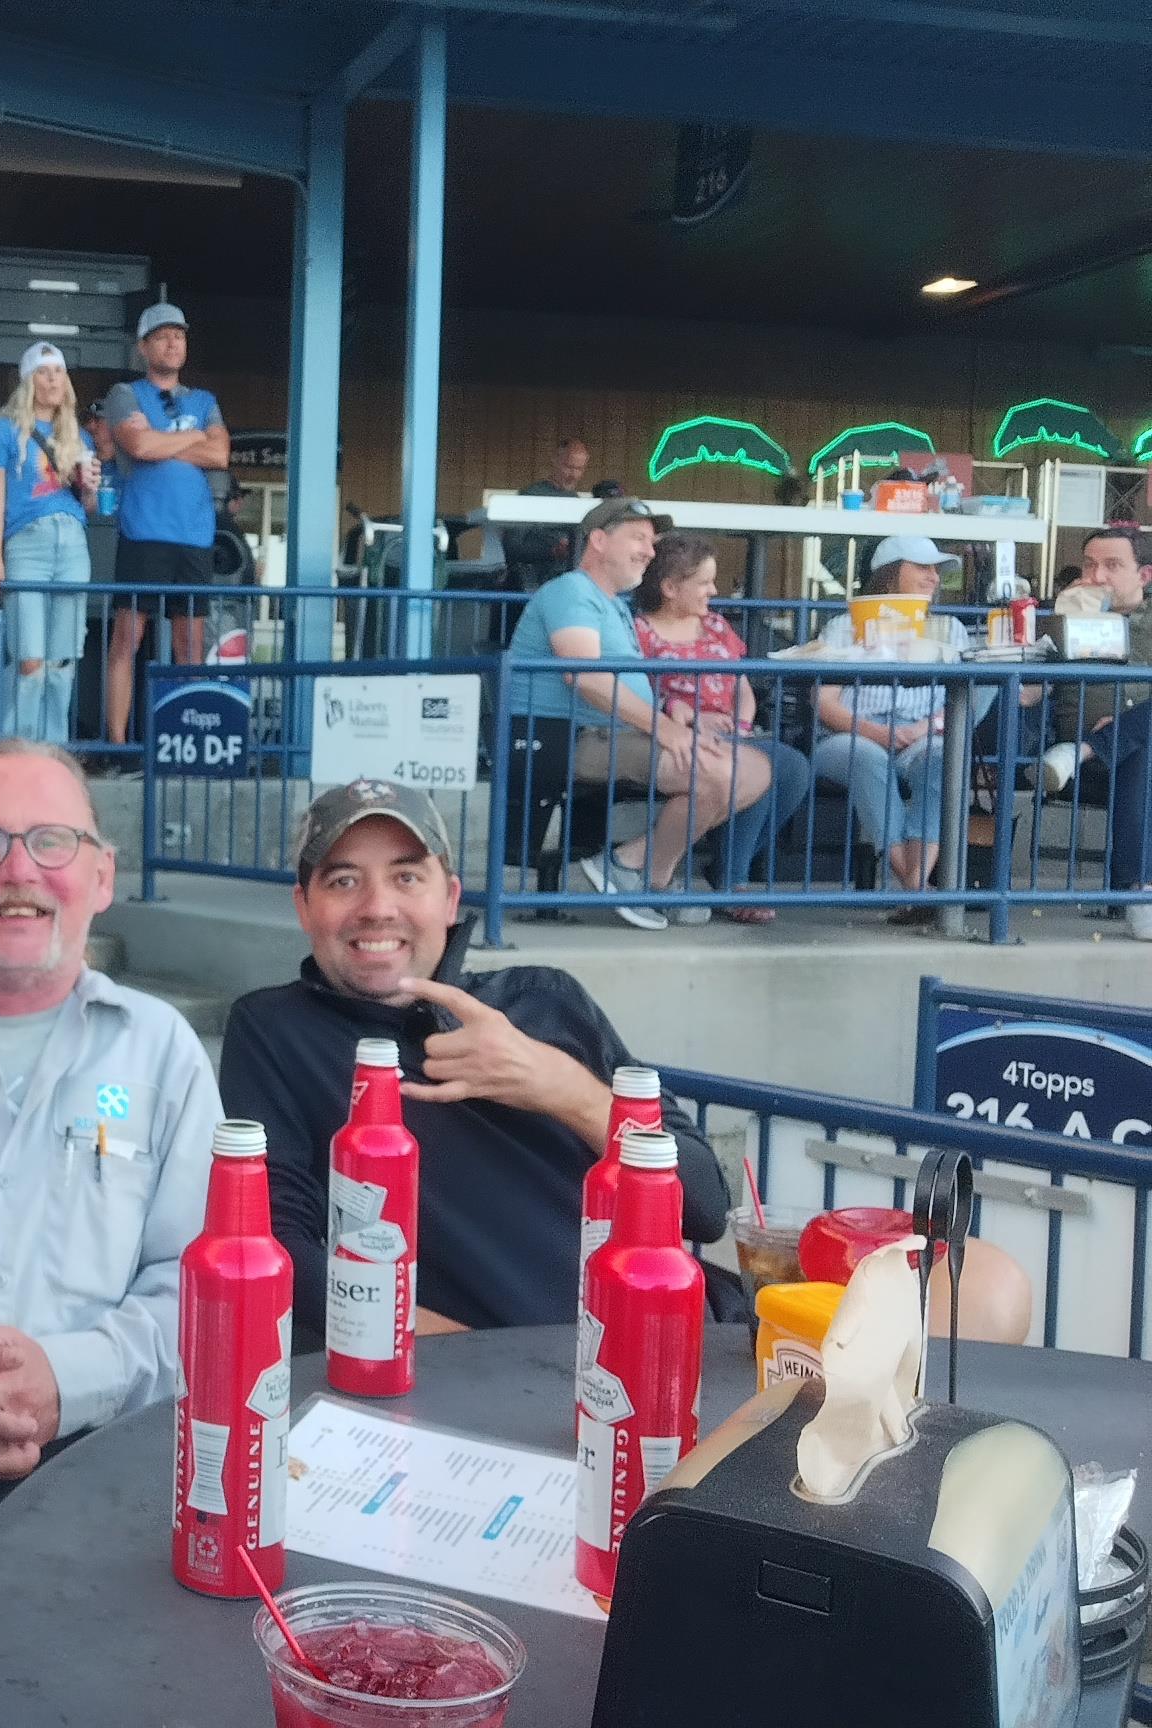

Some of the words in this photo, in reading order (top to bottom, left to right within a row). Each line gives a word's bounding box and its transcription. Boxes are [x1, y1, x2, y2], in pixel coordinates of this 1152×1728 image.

[157, 733, 198, 764] 216
[204, 734, 243, 766] D-F
[394, 761, 404, 779] 4
[408, 760, 467, 785] Topps
[1002, 1061, 1095, 1102] 4Topps
[247, 1422, 262, 1550] GENUINE
